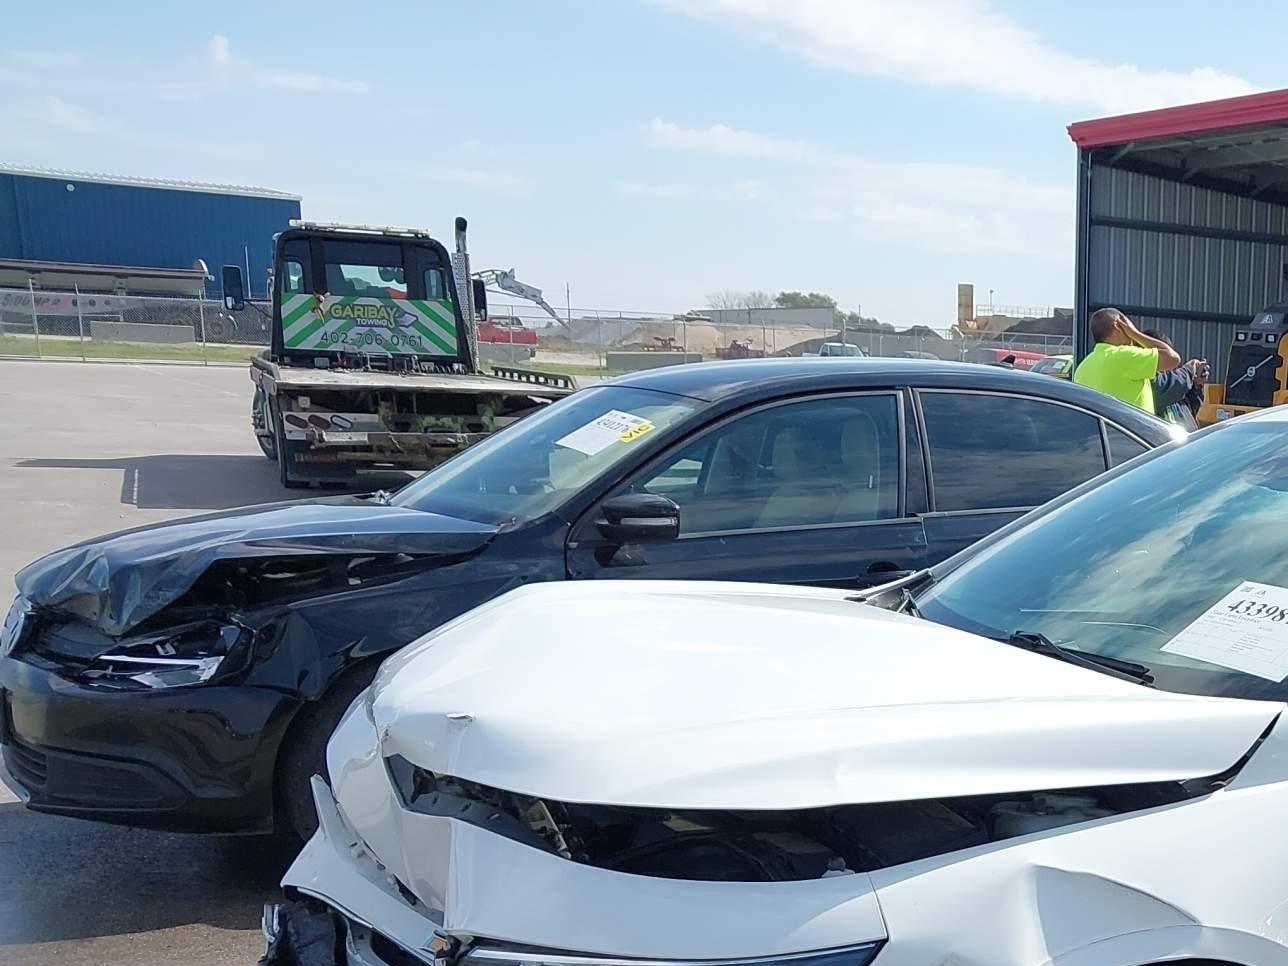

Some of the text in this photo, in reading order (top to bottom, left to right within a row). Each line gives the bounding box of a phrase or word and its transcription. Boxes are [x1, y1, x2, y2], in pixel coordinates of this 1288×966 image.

[331, 303, 397, 329] GARIBAY
[356, 318, 388, 326] TOWING
[320, 331, 423, 347] 402-706-0761
